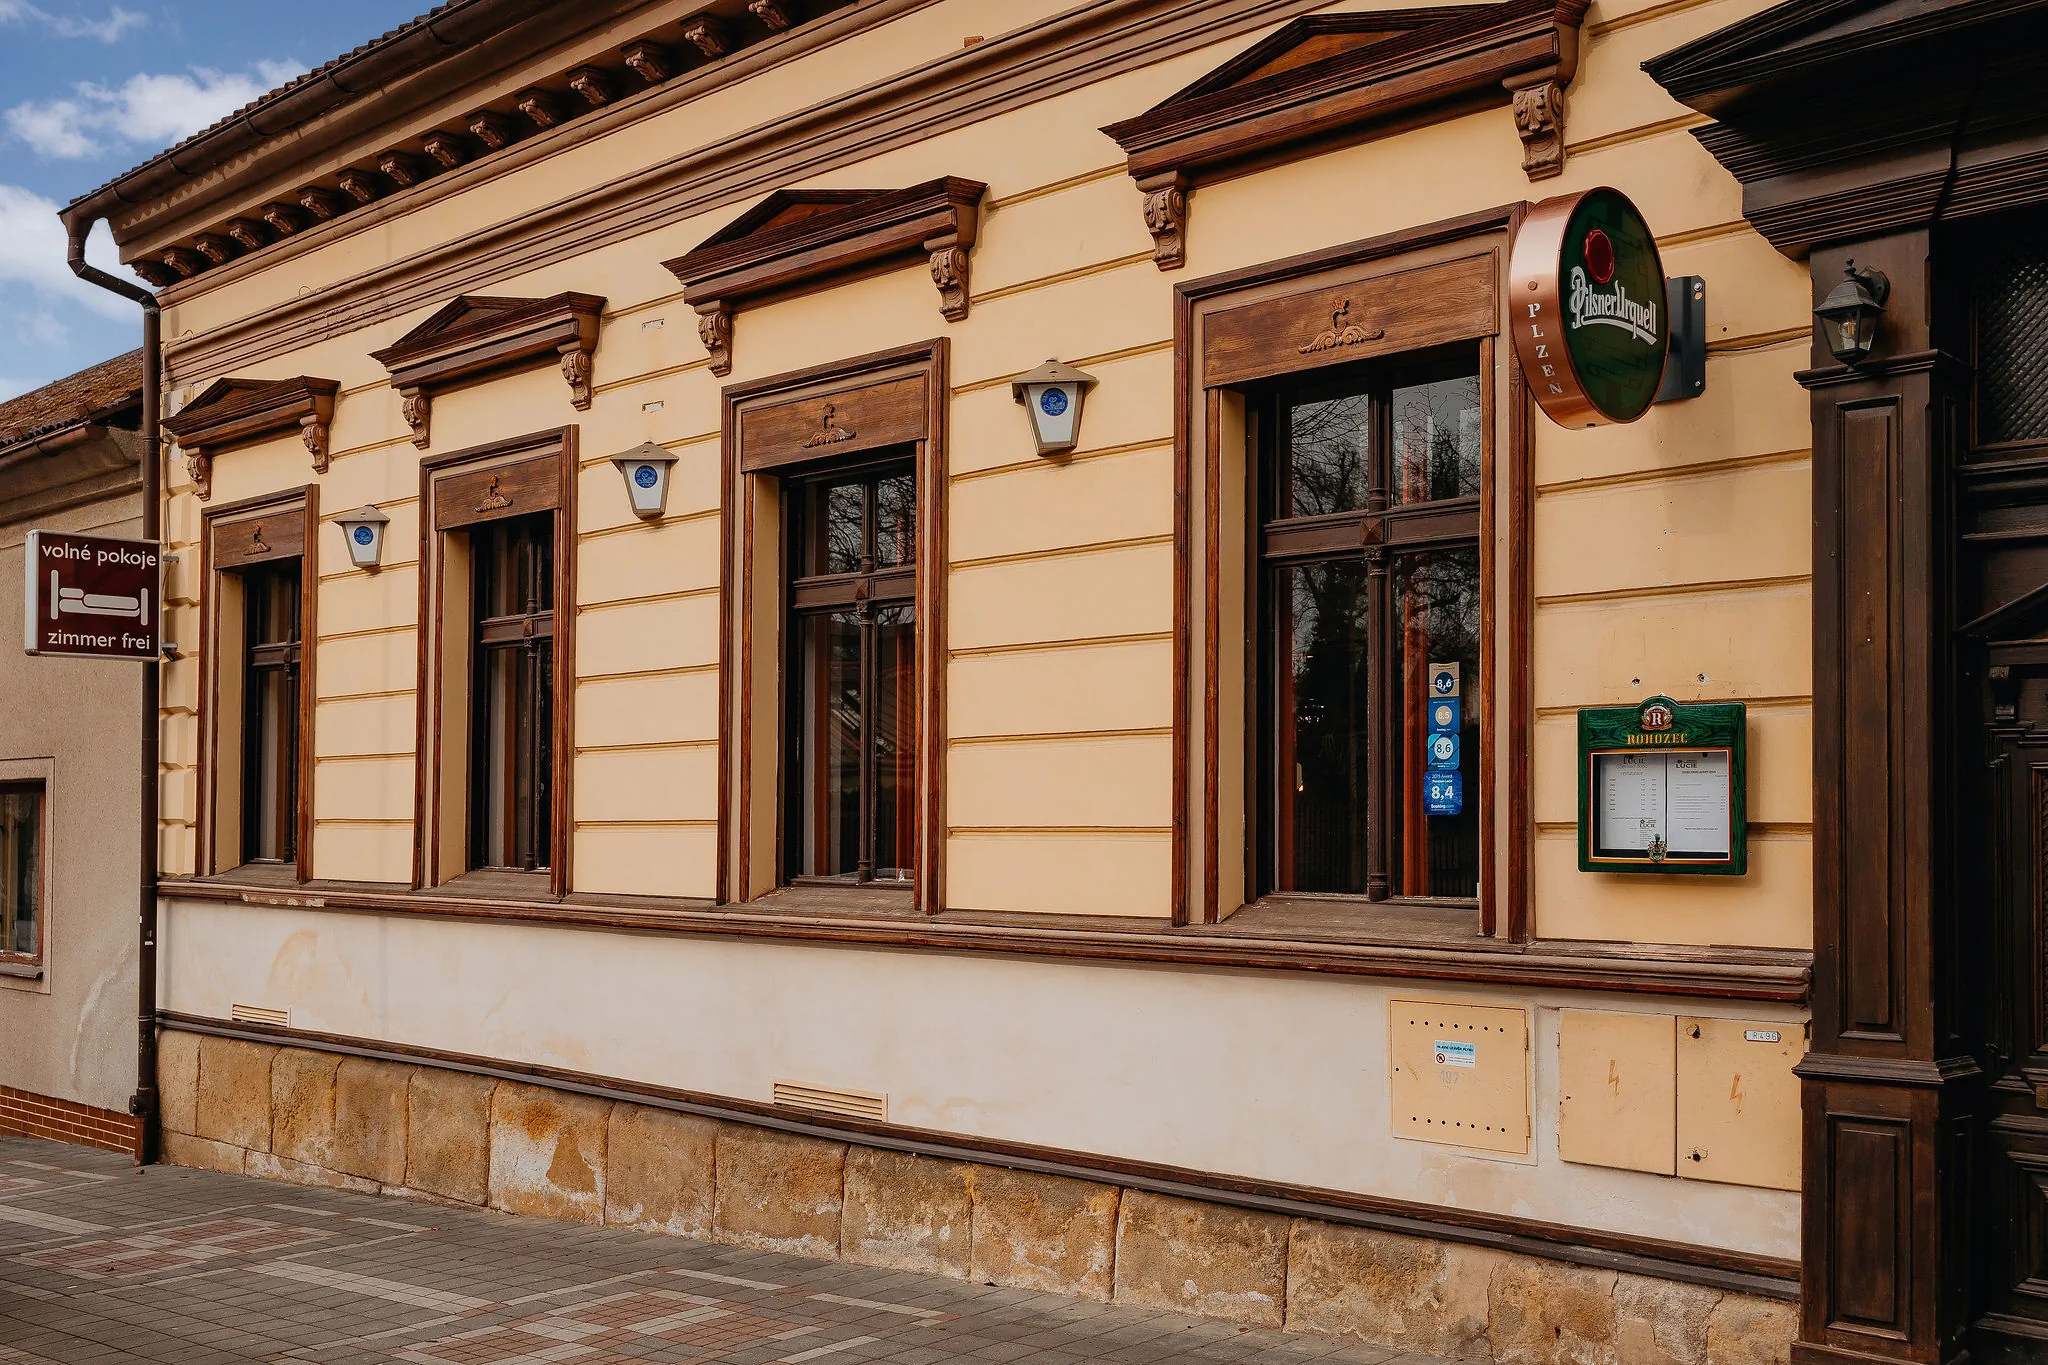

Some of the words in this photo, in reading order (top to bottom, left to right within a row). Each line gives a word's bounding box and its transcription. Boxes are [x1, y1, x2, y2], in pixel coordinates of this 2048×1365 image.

[1569, 266, 1617, 330] Pilsner
[1614, 279, 1657, 340] Urquell
[1527, 302, 1563, 394] PLZEN
[42, 542, 91, 561] volné
[97, 548, 157, 570] pokoje
[47, 629, 116, 647] zimmer
[121, 633, 150, 650] frei
[1436, 678, 1452, 690] 8,6
[1651, 712, 1662, 726] R
[1627, 733, 1688, 745] ROHOZEC
[1436, 743, 1451, 755] 8,6
[1431, 785, 1454, 800] 8,4
